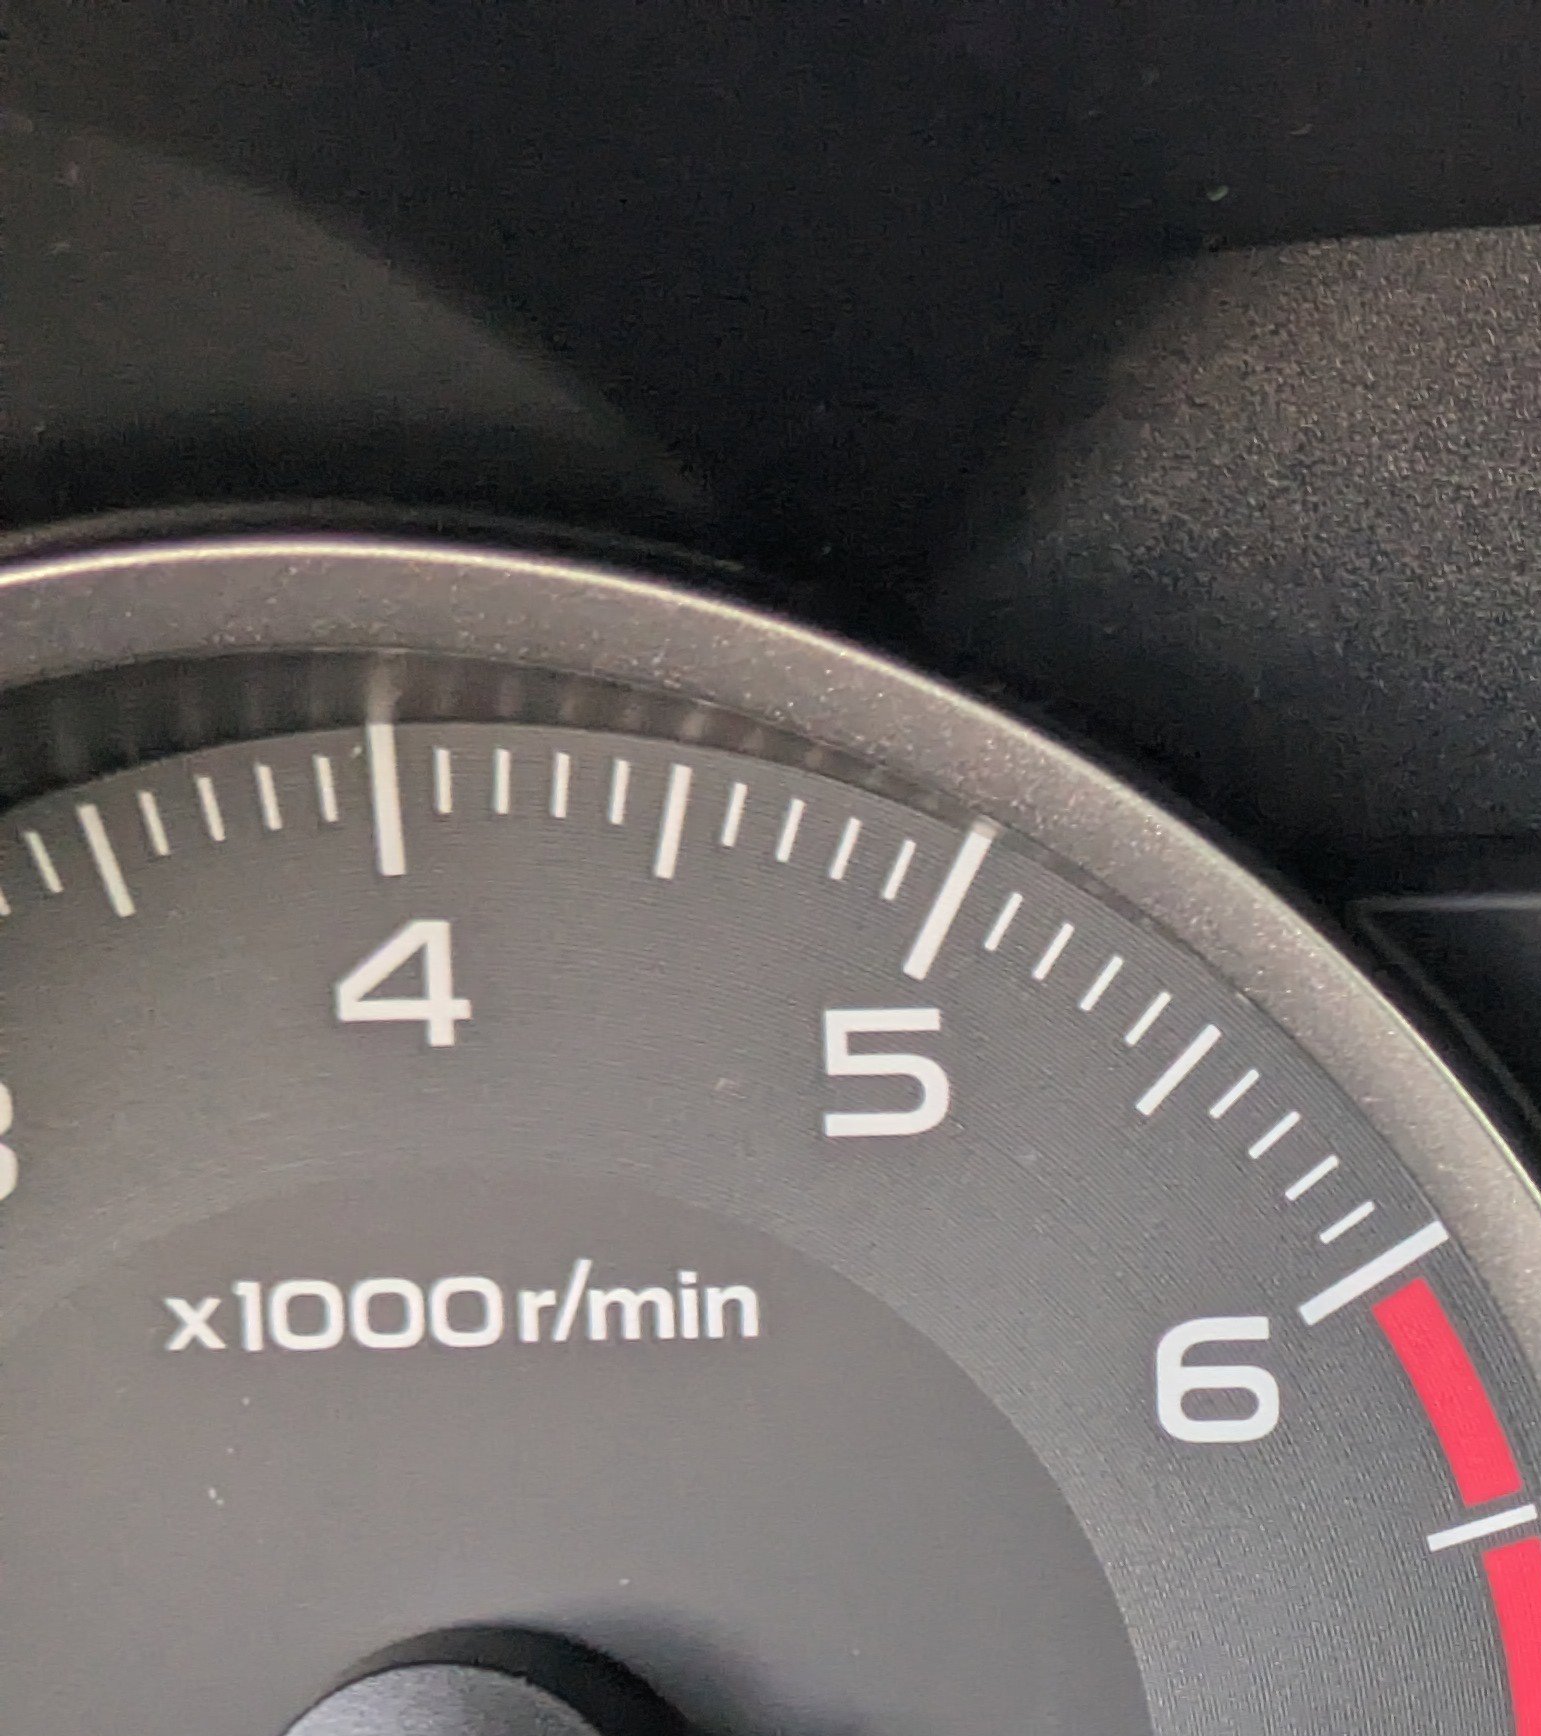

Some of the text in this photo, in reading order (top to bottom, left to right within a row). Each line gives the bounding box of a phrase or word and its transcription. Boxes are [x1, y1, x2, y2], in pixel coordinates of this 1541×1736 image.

[337, 919, 472, 1047] 4
[823, 1007, 950, 1137] 5
[1155, 1315, 1280, 1443] 6
